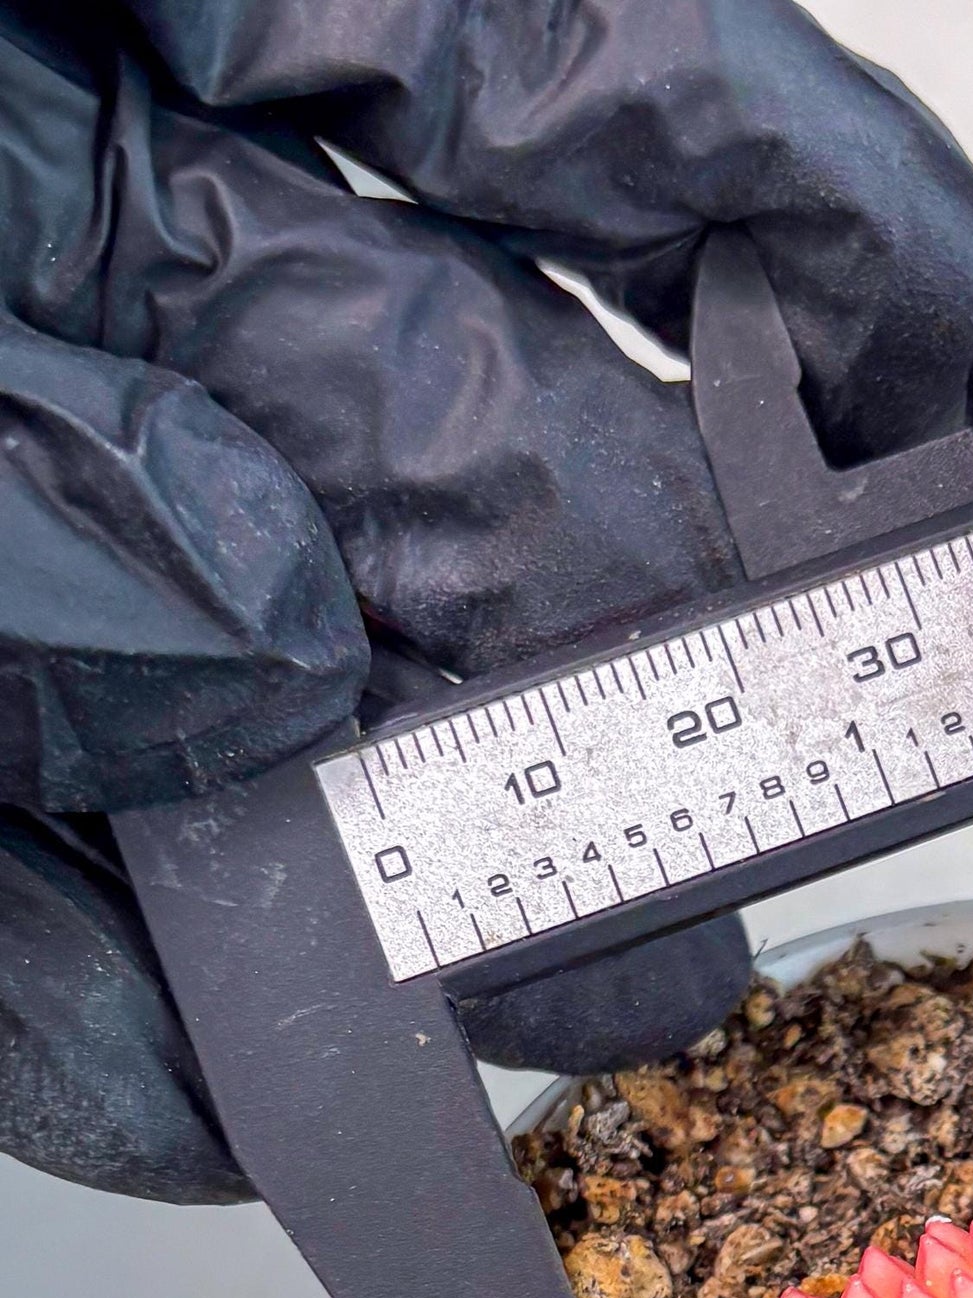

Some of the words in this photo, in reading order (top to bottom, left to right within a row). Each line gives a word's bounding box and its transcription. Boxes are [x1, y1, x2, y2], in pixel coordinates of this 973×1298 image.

[375, 845, 412, 883] 0
[452, 888, 464, 908] 1
[487, 874, 513, 897] 2
[533, 857, 557, 879] 3
[582, 841, 601, 863] 4
[624, 824, 647, 847] 5
[670, 808, 693, 832] 6
[719, 791, 737, 815] 7
[759, 776, 785, 799] 8
[806, 760, 829, 784] 9
[845, 720, 865, 752] 1
[906, 727, 918, 746] 1
[941, 711, 965, 735] 2
[504, 760, 561, 805] 10
[667, 696, 742, 749] 20
[846, 632, 922, 683] 30
